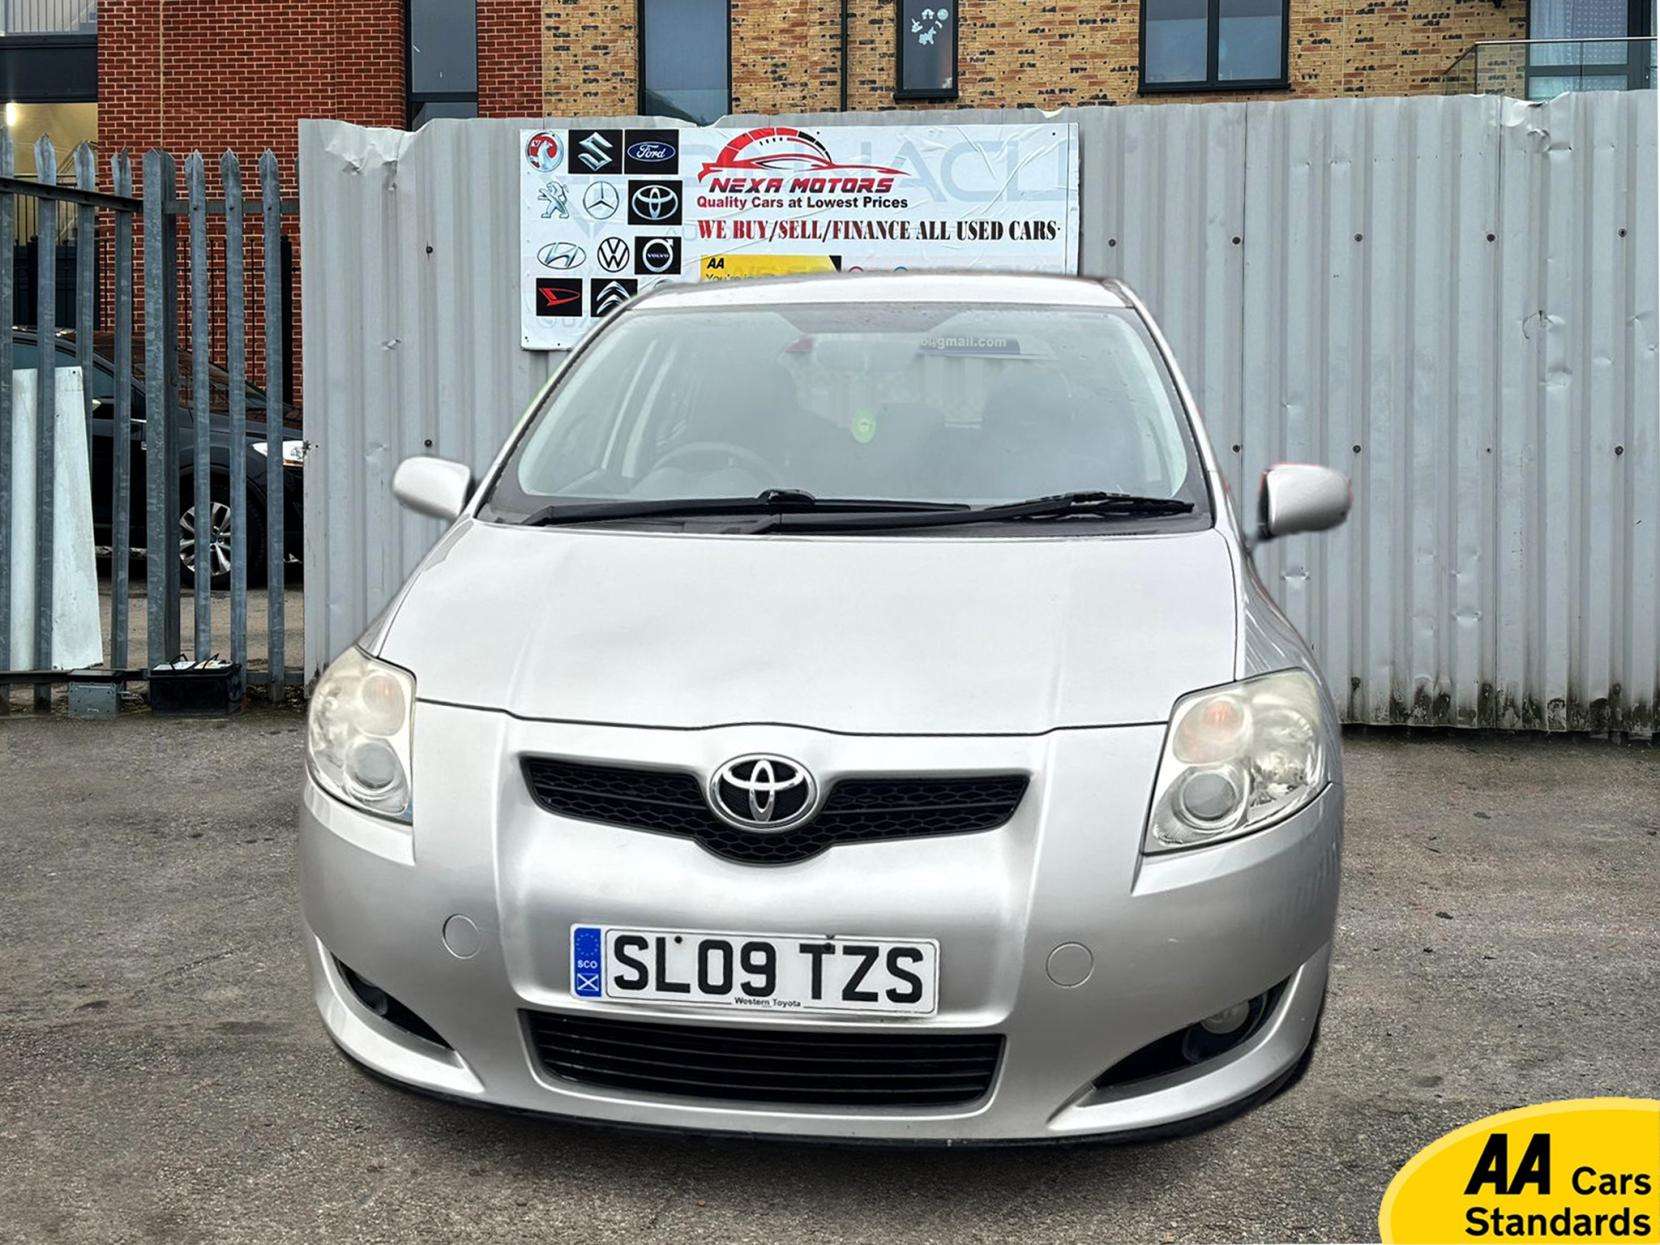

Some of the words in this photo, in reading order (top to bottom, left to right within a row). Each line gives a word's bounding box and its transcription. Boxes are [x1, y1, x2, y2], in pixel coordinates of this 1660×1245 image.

[636, 143, 667, 159] Ford
[709, 178, 783, 193] NEXA
[789, 177, 895, 193] MOTORS
[696, 196, 747, 210] Quality
[751, 196, 784, 208] Cars
[788, 197, 802, 208] at
[807, 196, 859, 208] Lowest
[863, 196, 908, 208] Prices
[697, 219, 727, 240] WE
[733, 220, 910, 242] BUY/SELL/FINANCE
[915, 220, 951, 240] ALL
[956, 220, 1004, 240] USED
[1008, 220, 1057, 240] CARS
[647, 252, 670, 260] VOLVO
[707, 258, 724, 269] AA
[577, 960, 598, 969] SCO
[613, 935, 777, 998] SL09
[799, 943, 924, 1004] TZS
[734, 996, 770, 1006] Western
[772, 998, 801, 1008] Toyota
